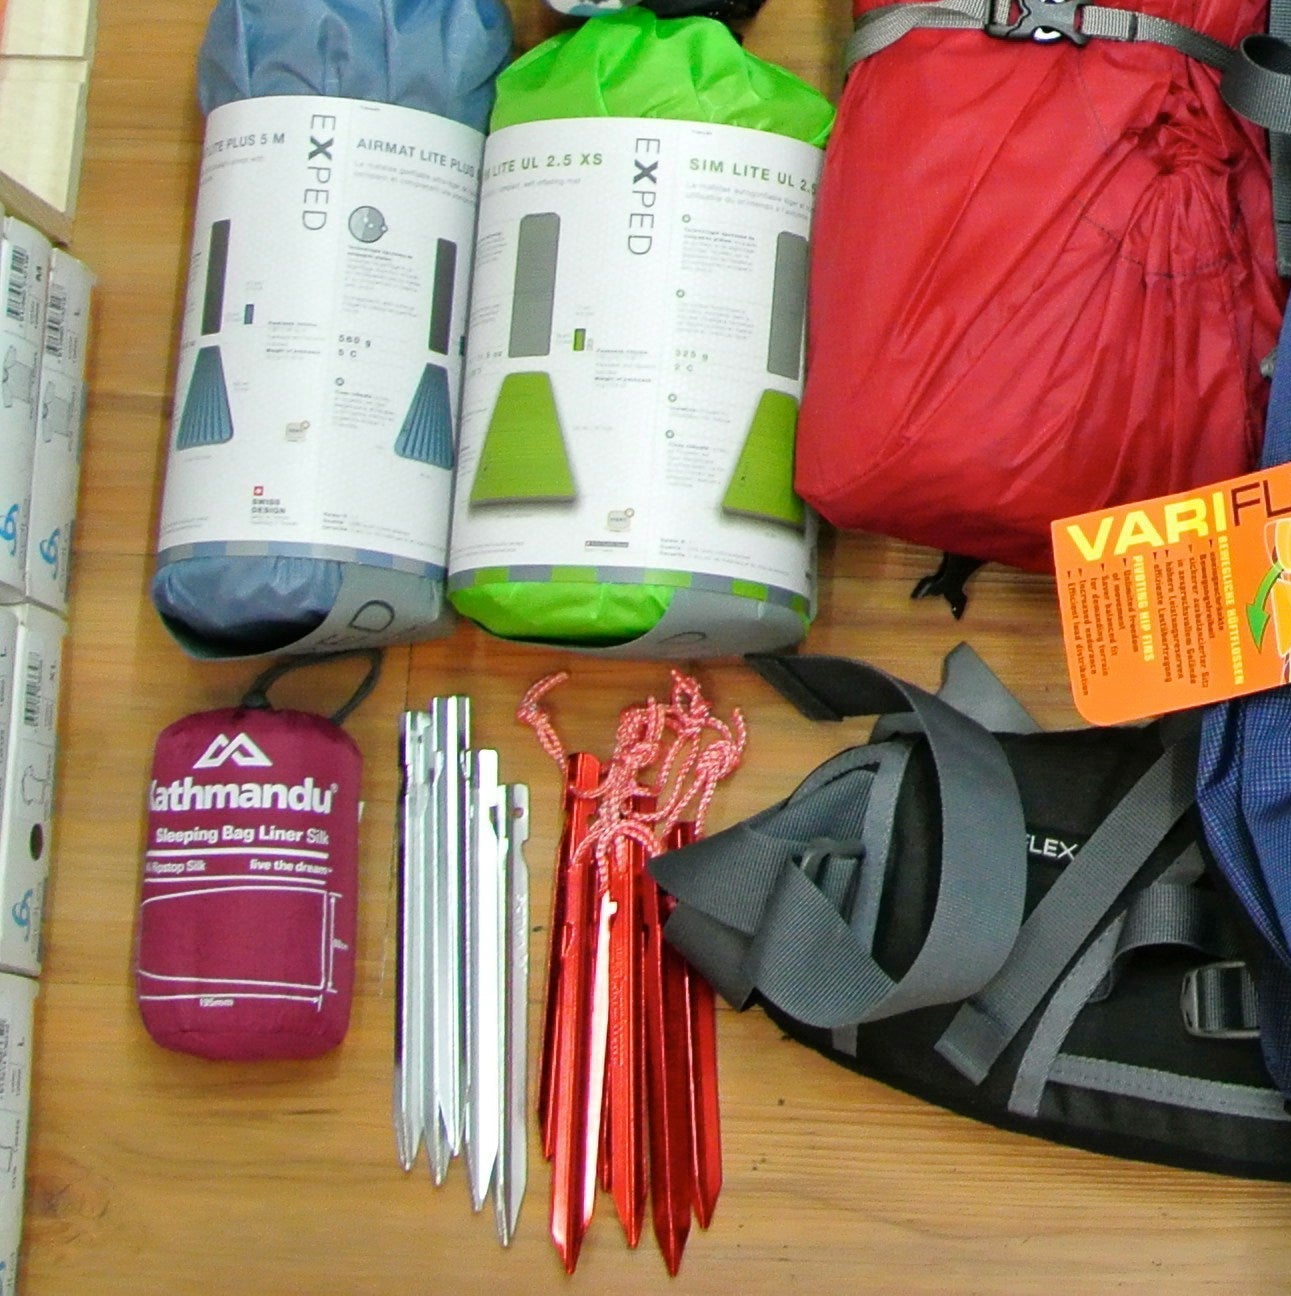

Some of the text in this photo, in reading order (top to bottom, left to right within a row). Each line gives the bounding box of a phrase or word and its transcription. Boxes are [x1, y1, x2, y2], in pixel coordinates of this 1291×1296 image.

[227, 132, 285, 150] PLUS 5 M
[356, 137, 475, 178] AIRMAT LITE PLUS
[521, 157, 539, 171] UL
[546, 153, 572, 168] 2.5
[579, 152, 603, 166] XS
[302, 114, 336, 231] EXPED
[689, 157, 726, 174] SIM
[732, 163, 771, 182] LITE
[777, 172, 796, 188] UL
[627, 137, 661, 255] EXPED
[251, 506, 286, 515] DESIGN
[1133, 555, 1155, 661] PIVOTING HIP FINS
[156, 825, 330, 845] Sleeping Bag Liner Silk
[186, 859, 207, 872] Silk
[249, 859, 271, 870] live
[274, 860, 293, 871] the
